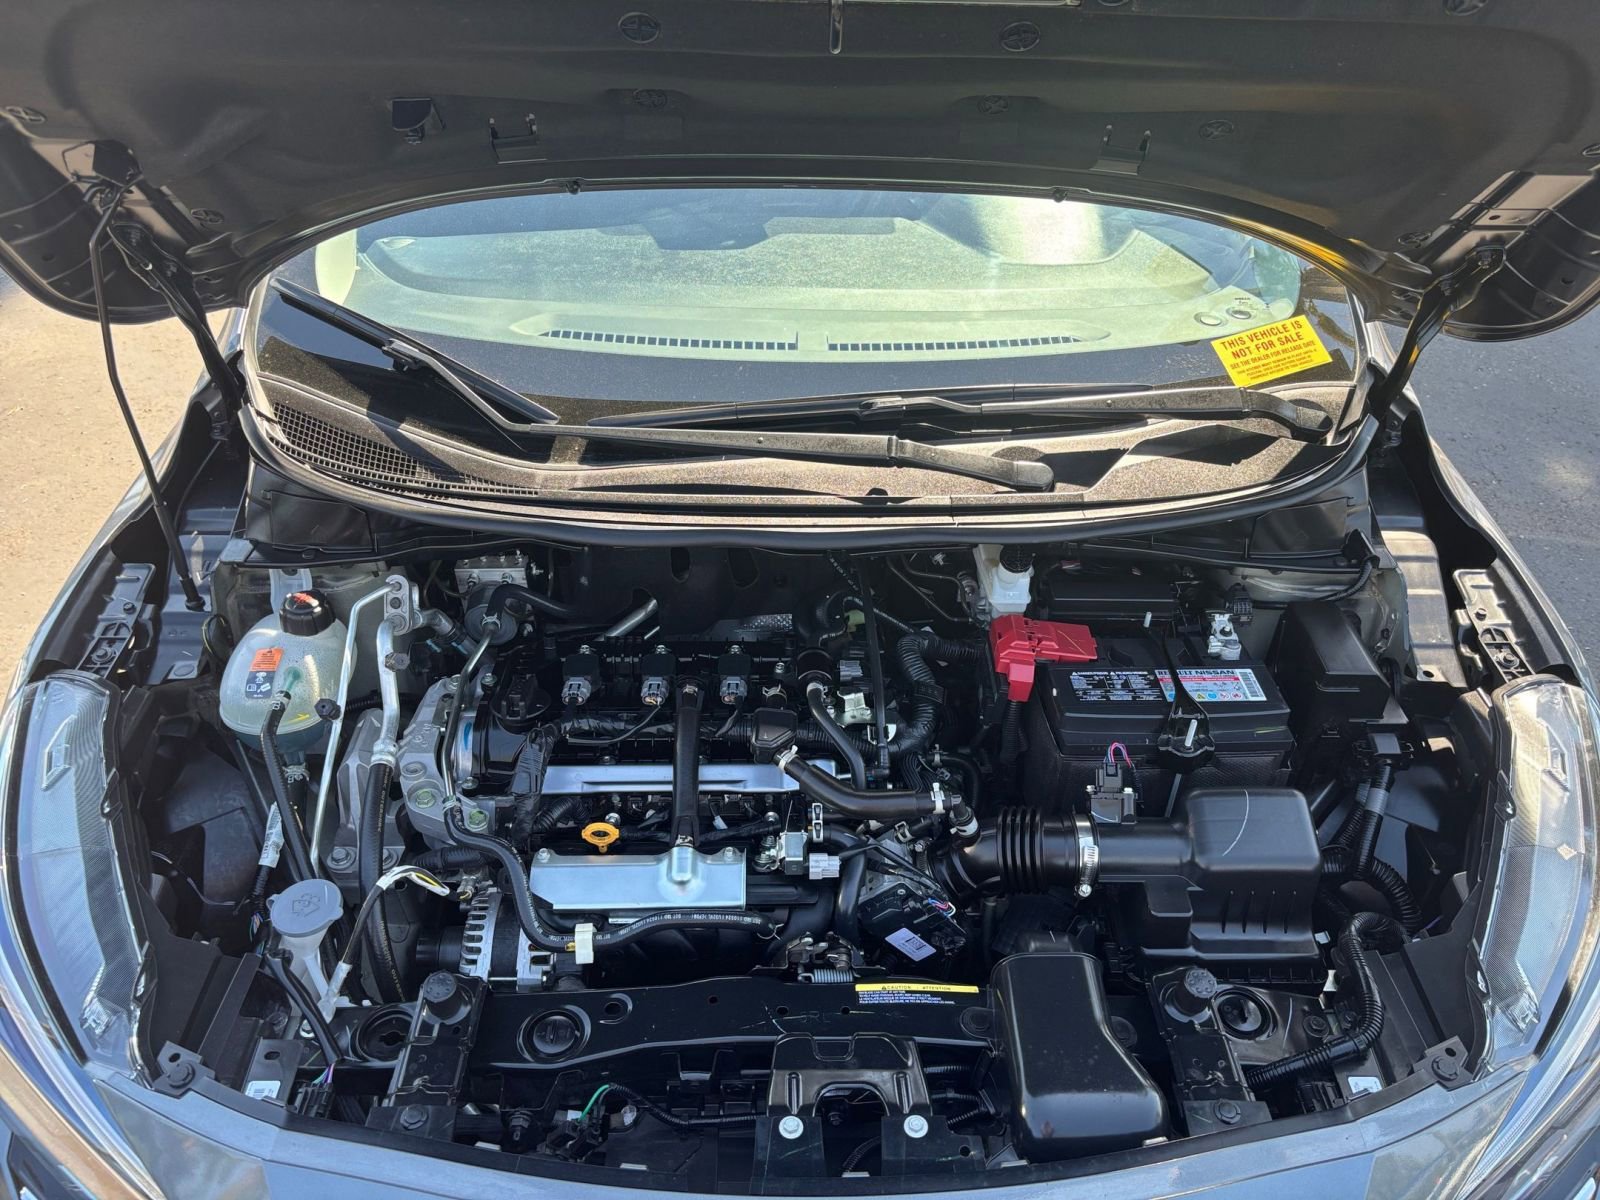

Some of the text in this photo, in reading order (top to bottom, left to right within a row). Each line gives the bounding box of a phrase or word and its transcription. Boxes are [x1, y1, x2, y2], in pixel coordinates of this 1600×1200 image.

[1221, 320, 1303, 351] THIS VEHICLE IS
[1231, 331, 1304, 360] NOT FOR SALE
[1240, 359, 1252, 368] THE
[1251, 353, 1271, 365] DEALER
[1270, 351, 1281, 360] FOR
[1281, 344, 1302, 356] RELEASE
[1302, 340, 1316, 349] DATE
